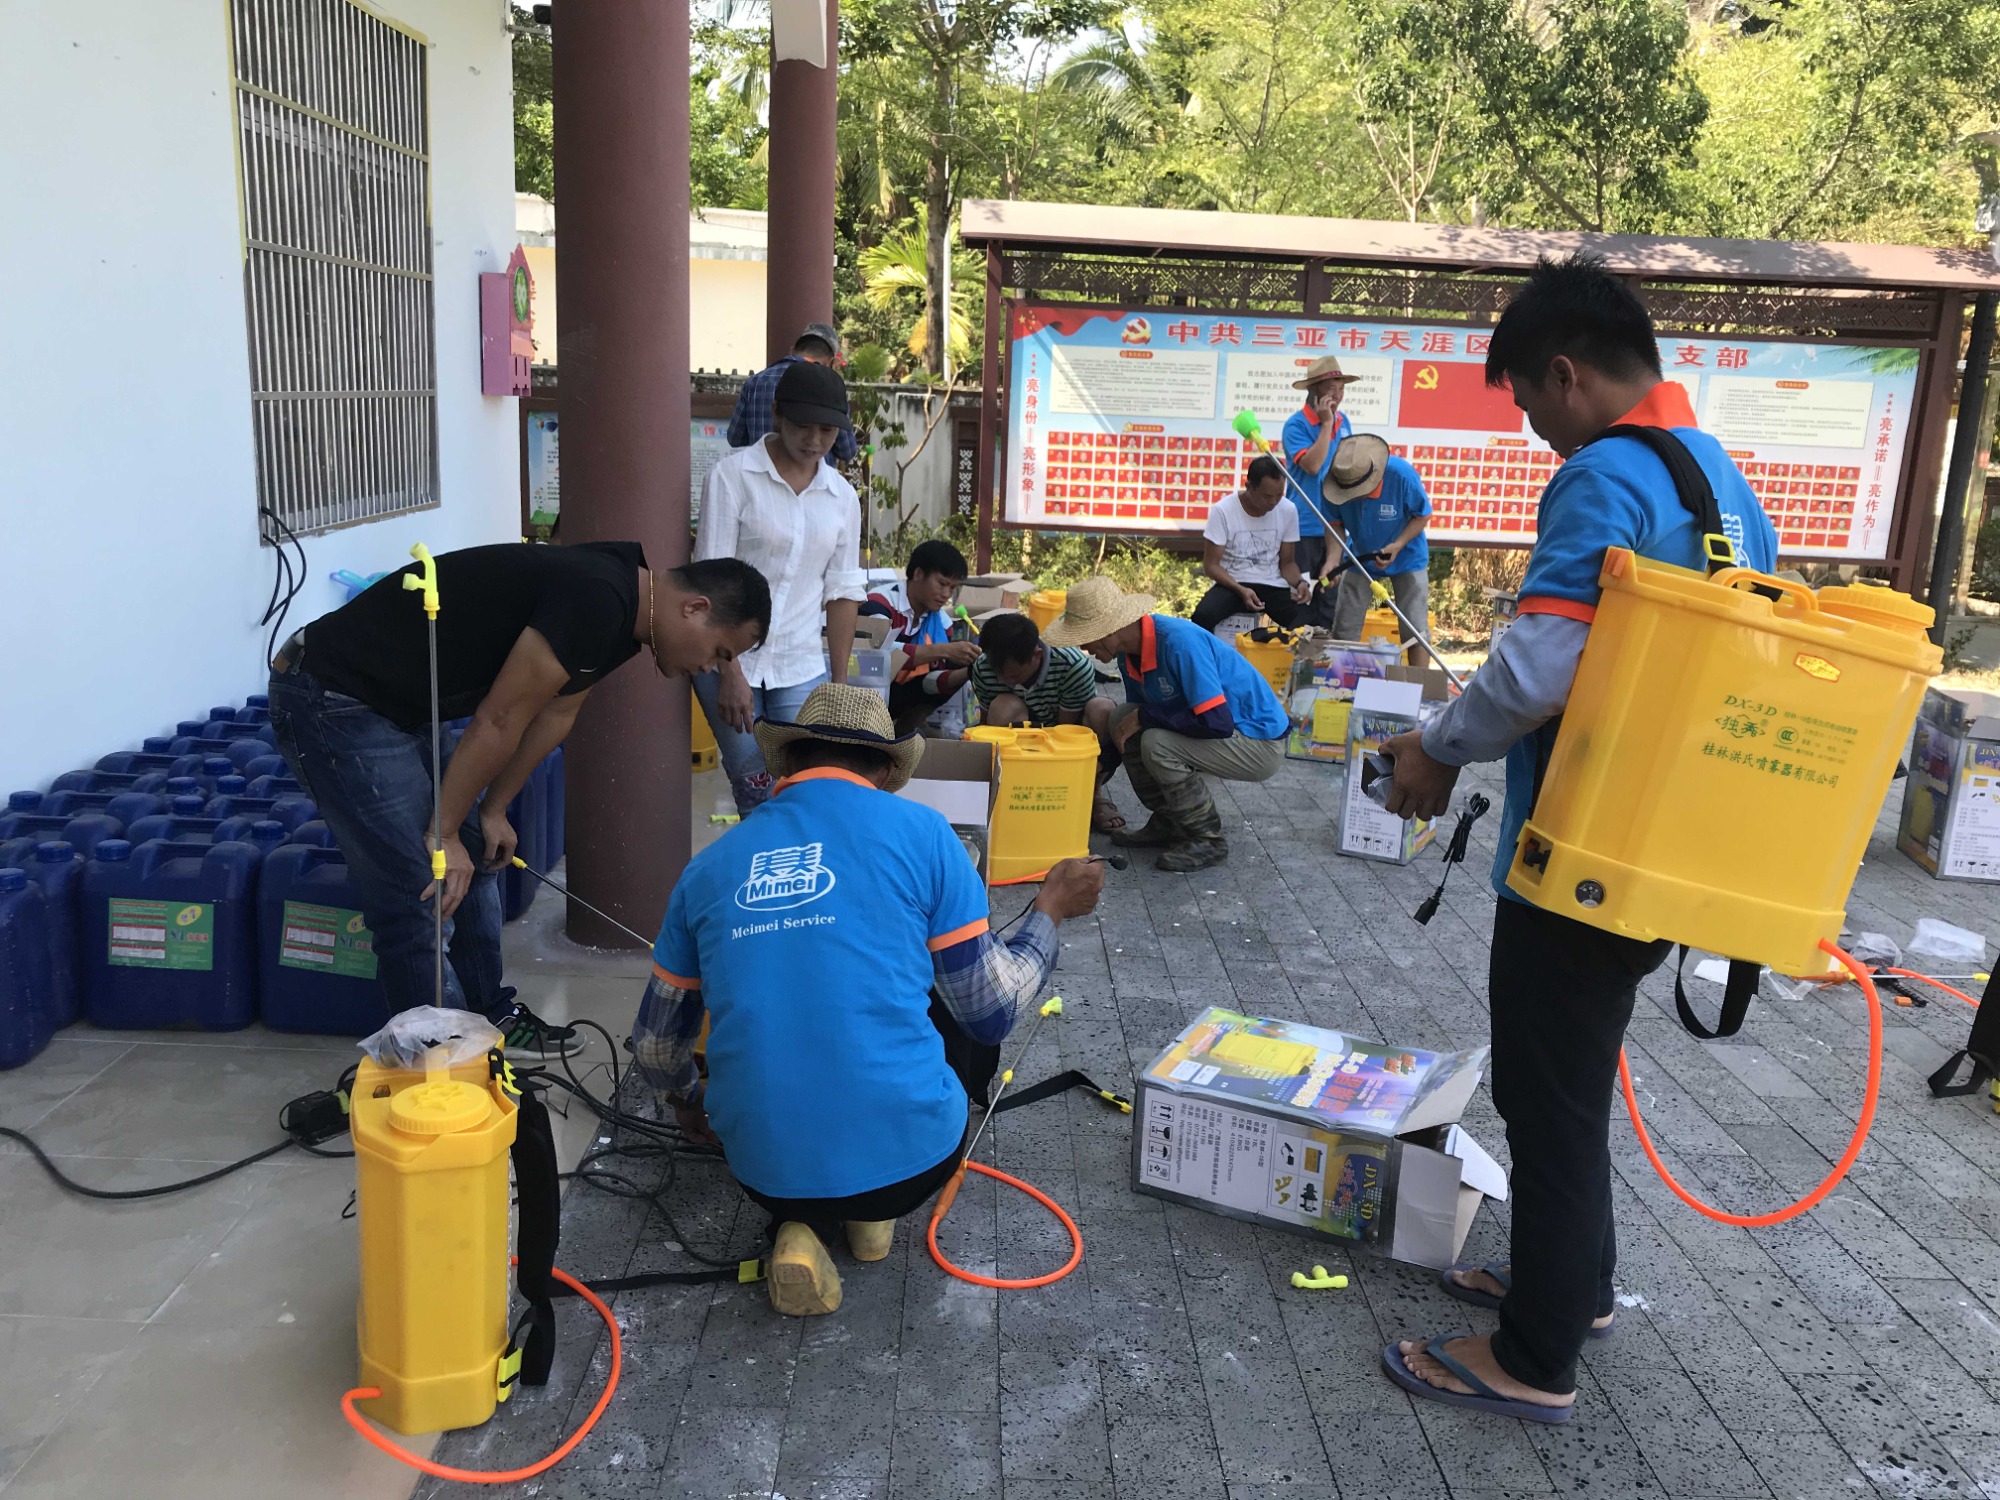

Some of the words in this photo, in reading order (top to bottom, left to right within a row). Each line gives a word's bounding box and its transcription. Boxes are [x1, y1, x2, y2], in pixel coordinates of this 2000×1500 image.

[1167, 320, 1493, 355] 中共三亚市天涯区
[1723, 695, 1777, 717] DX-3D
[749, 878, 814, 899] Mimei
[732, 919, 779, 940] Meimei
[783, 914, 836, 929] Service
[1357, 1164, 1377, 1220] DX-3D
